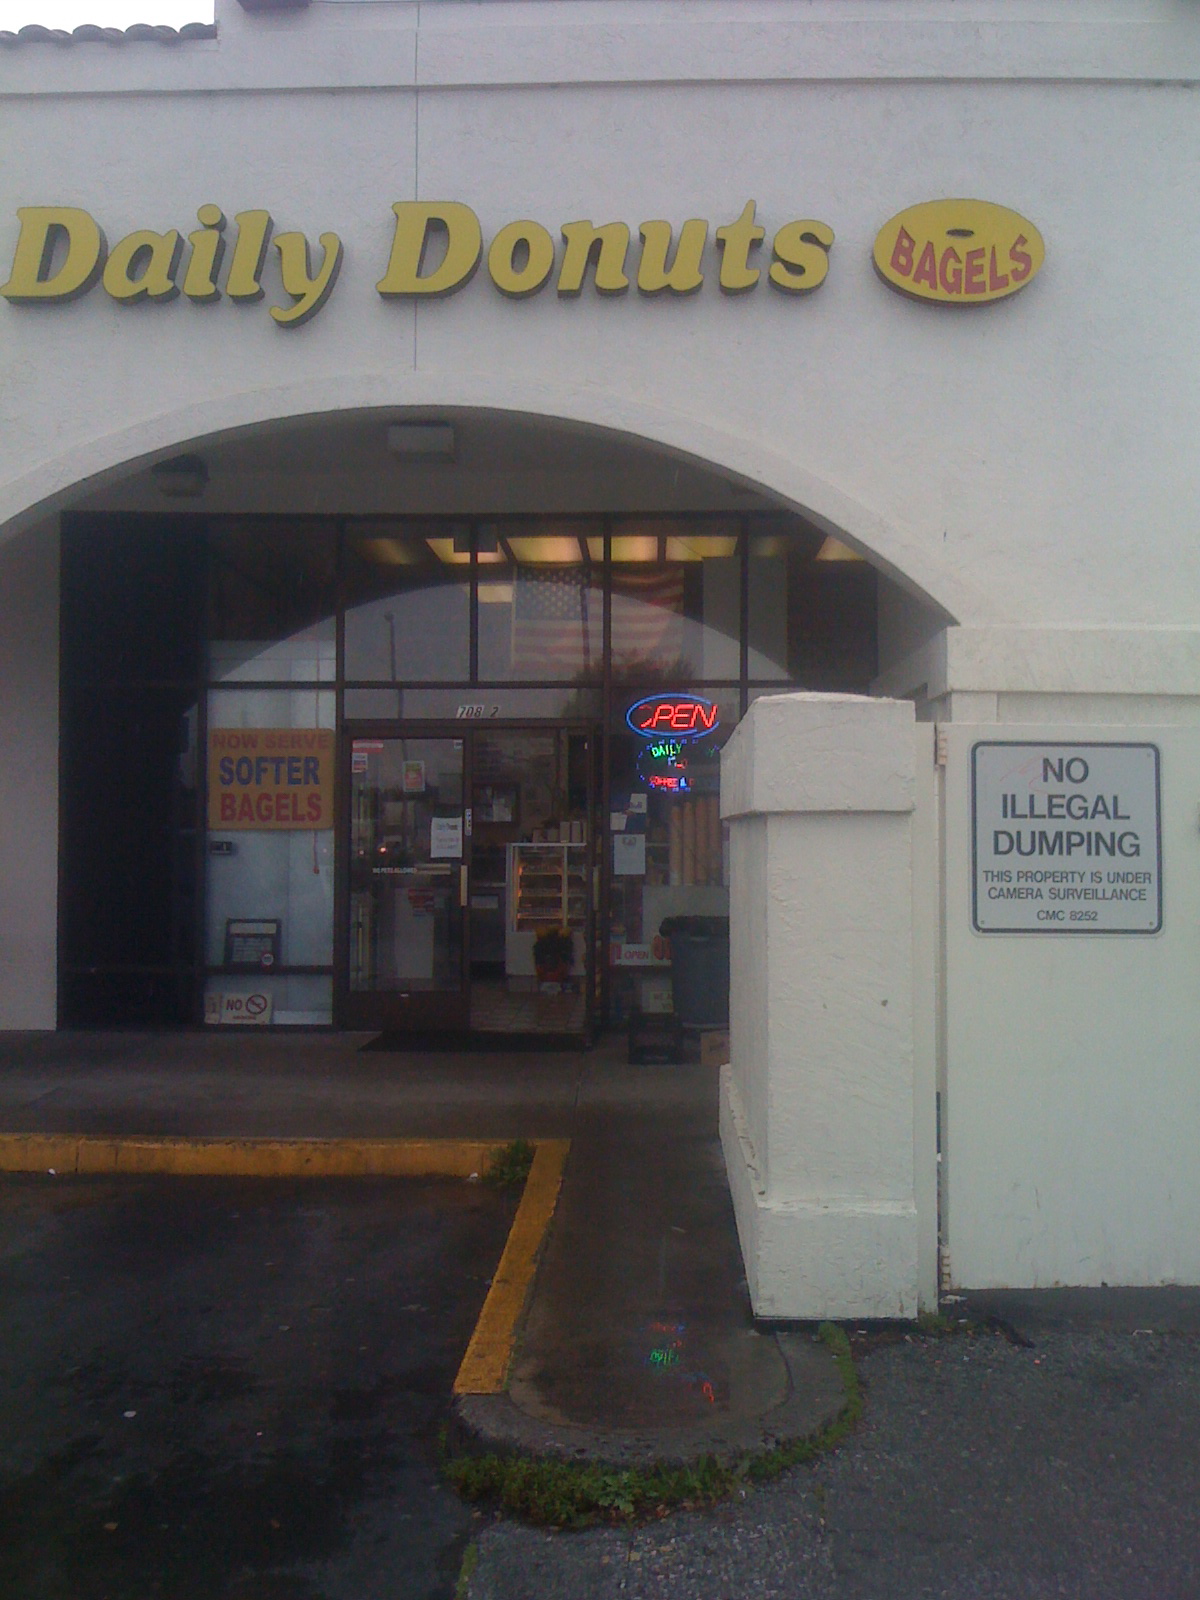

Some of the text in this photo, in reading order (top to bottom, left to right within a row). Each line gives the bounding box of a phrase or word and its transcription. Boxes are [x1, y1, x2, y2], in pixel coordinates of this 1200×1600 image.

[0, 199, 835, 326] Daily Donuts
[890, 225, 1033, 295] BAGELS
[211, 734, 329, 749] NOW SERVE
[651, 744, 682, 758] DAILY
[219, 756, 321, 786] SOFTER
[1042, 757, 1090, 784] NO
[220, 792, 323, 822] BAGELS
[1002, 793, 1130, 821] ILLEGAL
[993, 830, 1141, 858] DUMPING
[983, 870, 1152, 884] THIS PROPERTY IS UNDER
[988, 887, 1147, 901] CAMERA SURVEILLANCE
[1036, 910, 1098, 921] CMC 8252
[226, 998, 243, 1011] NO
